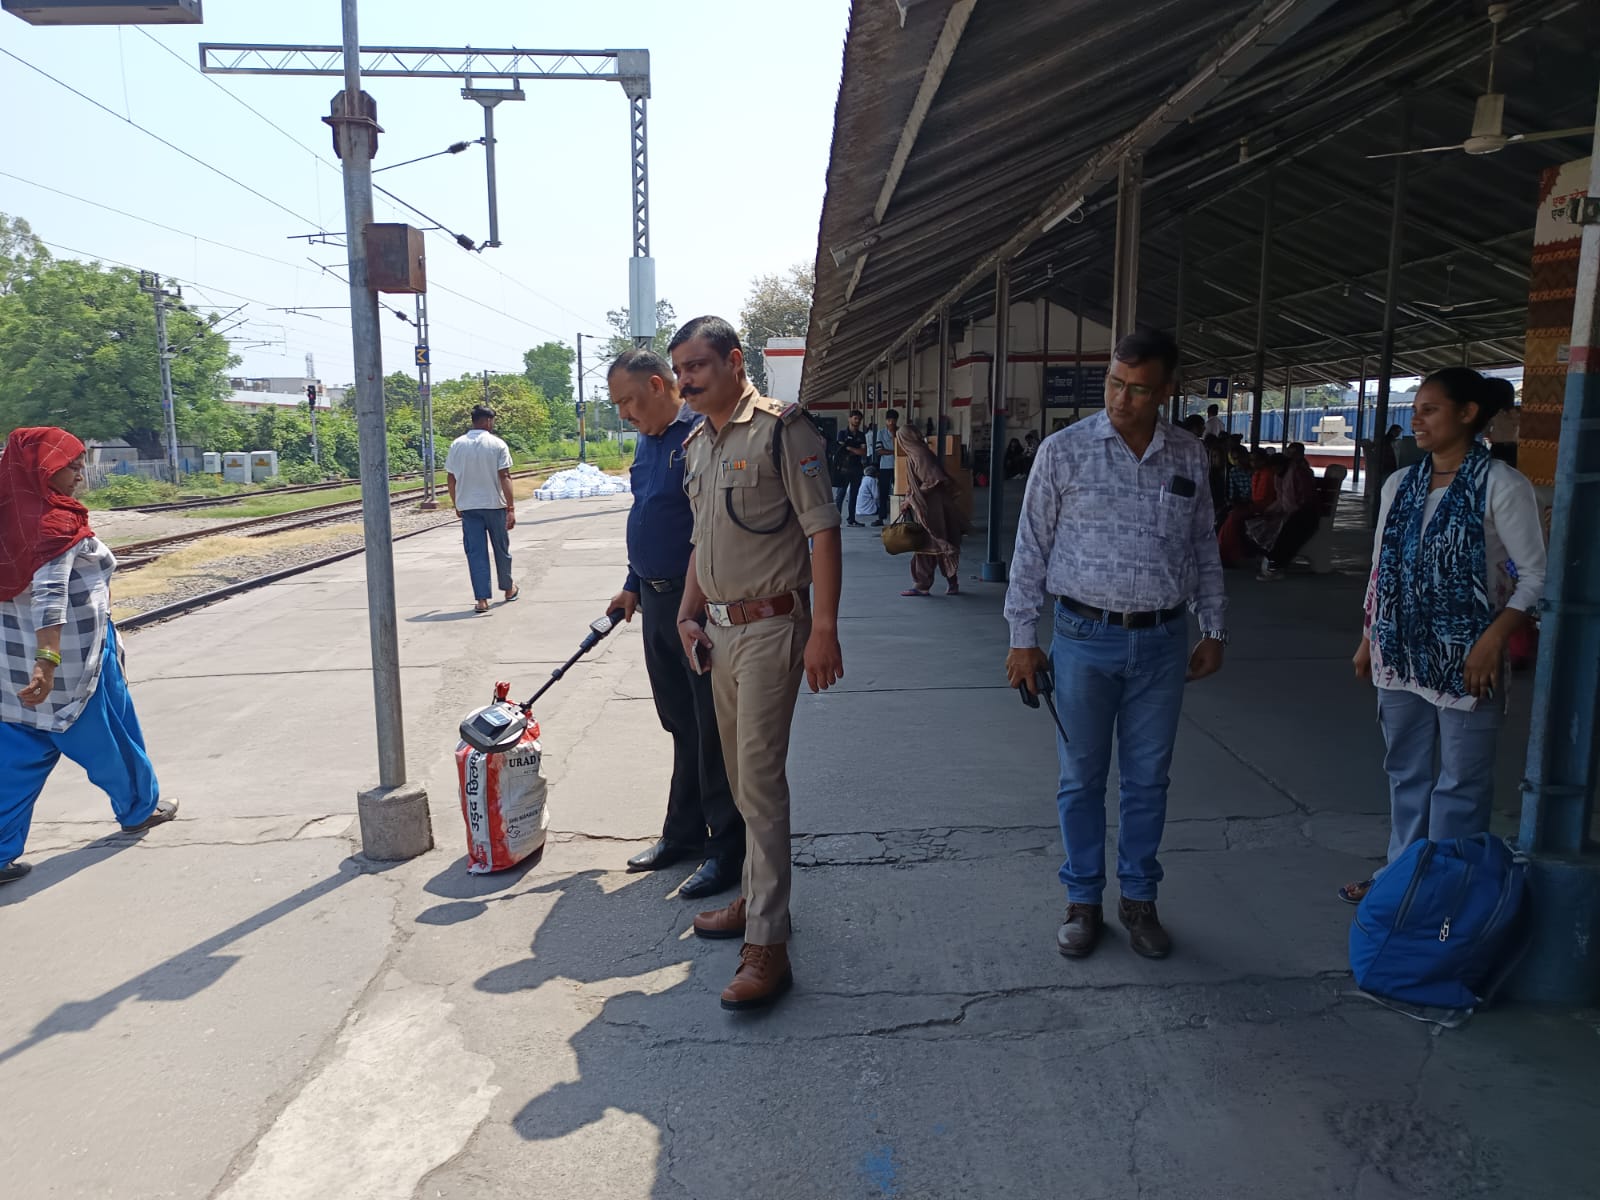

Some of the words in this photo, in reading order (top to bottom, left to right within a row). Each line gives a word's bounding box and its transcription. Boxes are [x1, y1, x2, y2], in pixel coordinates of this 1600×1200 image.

[868, 386, 875, 400] 3
[1214, 382, 1222, 395] 4
[509, 755, 536, 768] URAD
[471, 800, 483, 832] उड़द
